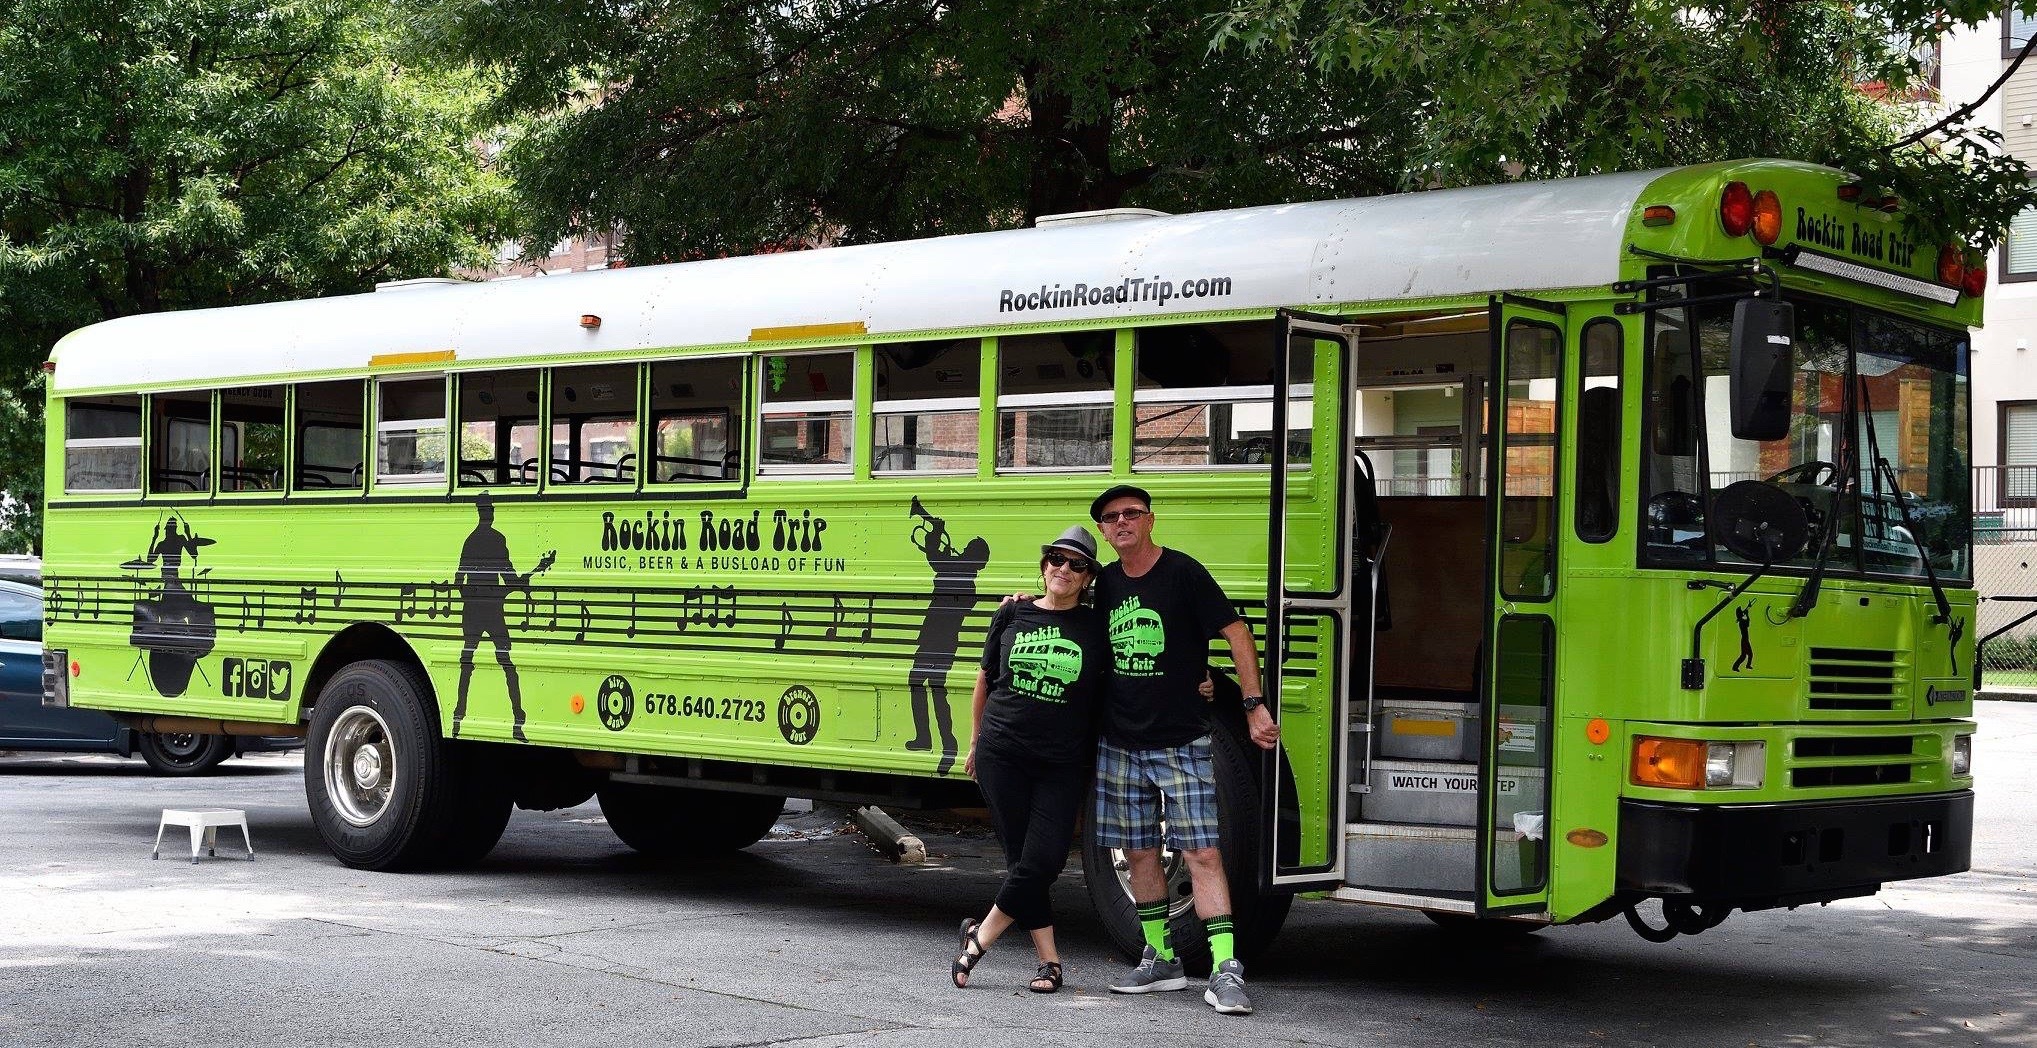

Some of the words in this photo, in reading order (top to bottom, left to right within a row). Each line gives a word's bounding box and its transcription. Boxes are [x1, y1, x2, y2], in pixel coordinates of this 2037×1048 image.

[1797, 207, 1845, 250] Rockin
[1852, 223, 1884, 261] Road
[1889, 231, 1915, 268] Trip
[1000, 275, 1232, 312] RockinRoadTrip.com
[602, 510, 687, 551] Rockin
[699, 510, 760, 551] Road
[773, 509, 827, 552] Trip
[583, 556, 632, 571] MUSIC,
[639, 556, 674, 570] BEER
[681, 556, 689, 570] &
[696, 556, 704, 570] A
[711, 557, 780, 571] BUSLOAD
[788, 557, 806, 572] OF
[815, 558, 846, 572] FUN
[1014, 626, 1061, 645] Rockin
[1133, 657, 1155, 670] Trip
[1013, 674, 1038, 692] Road
[1041, 680, 1065, 697] Trip
[645, 693, 766, 722] 678.640.2723
[607, 715, 625, 729] Band
[1393, 776, 1437, 788] WATCH
[1444, 777, 1478, 791] YOUR
